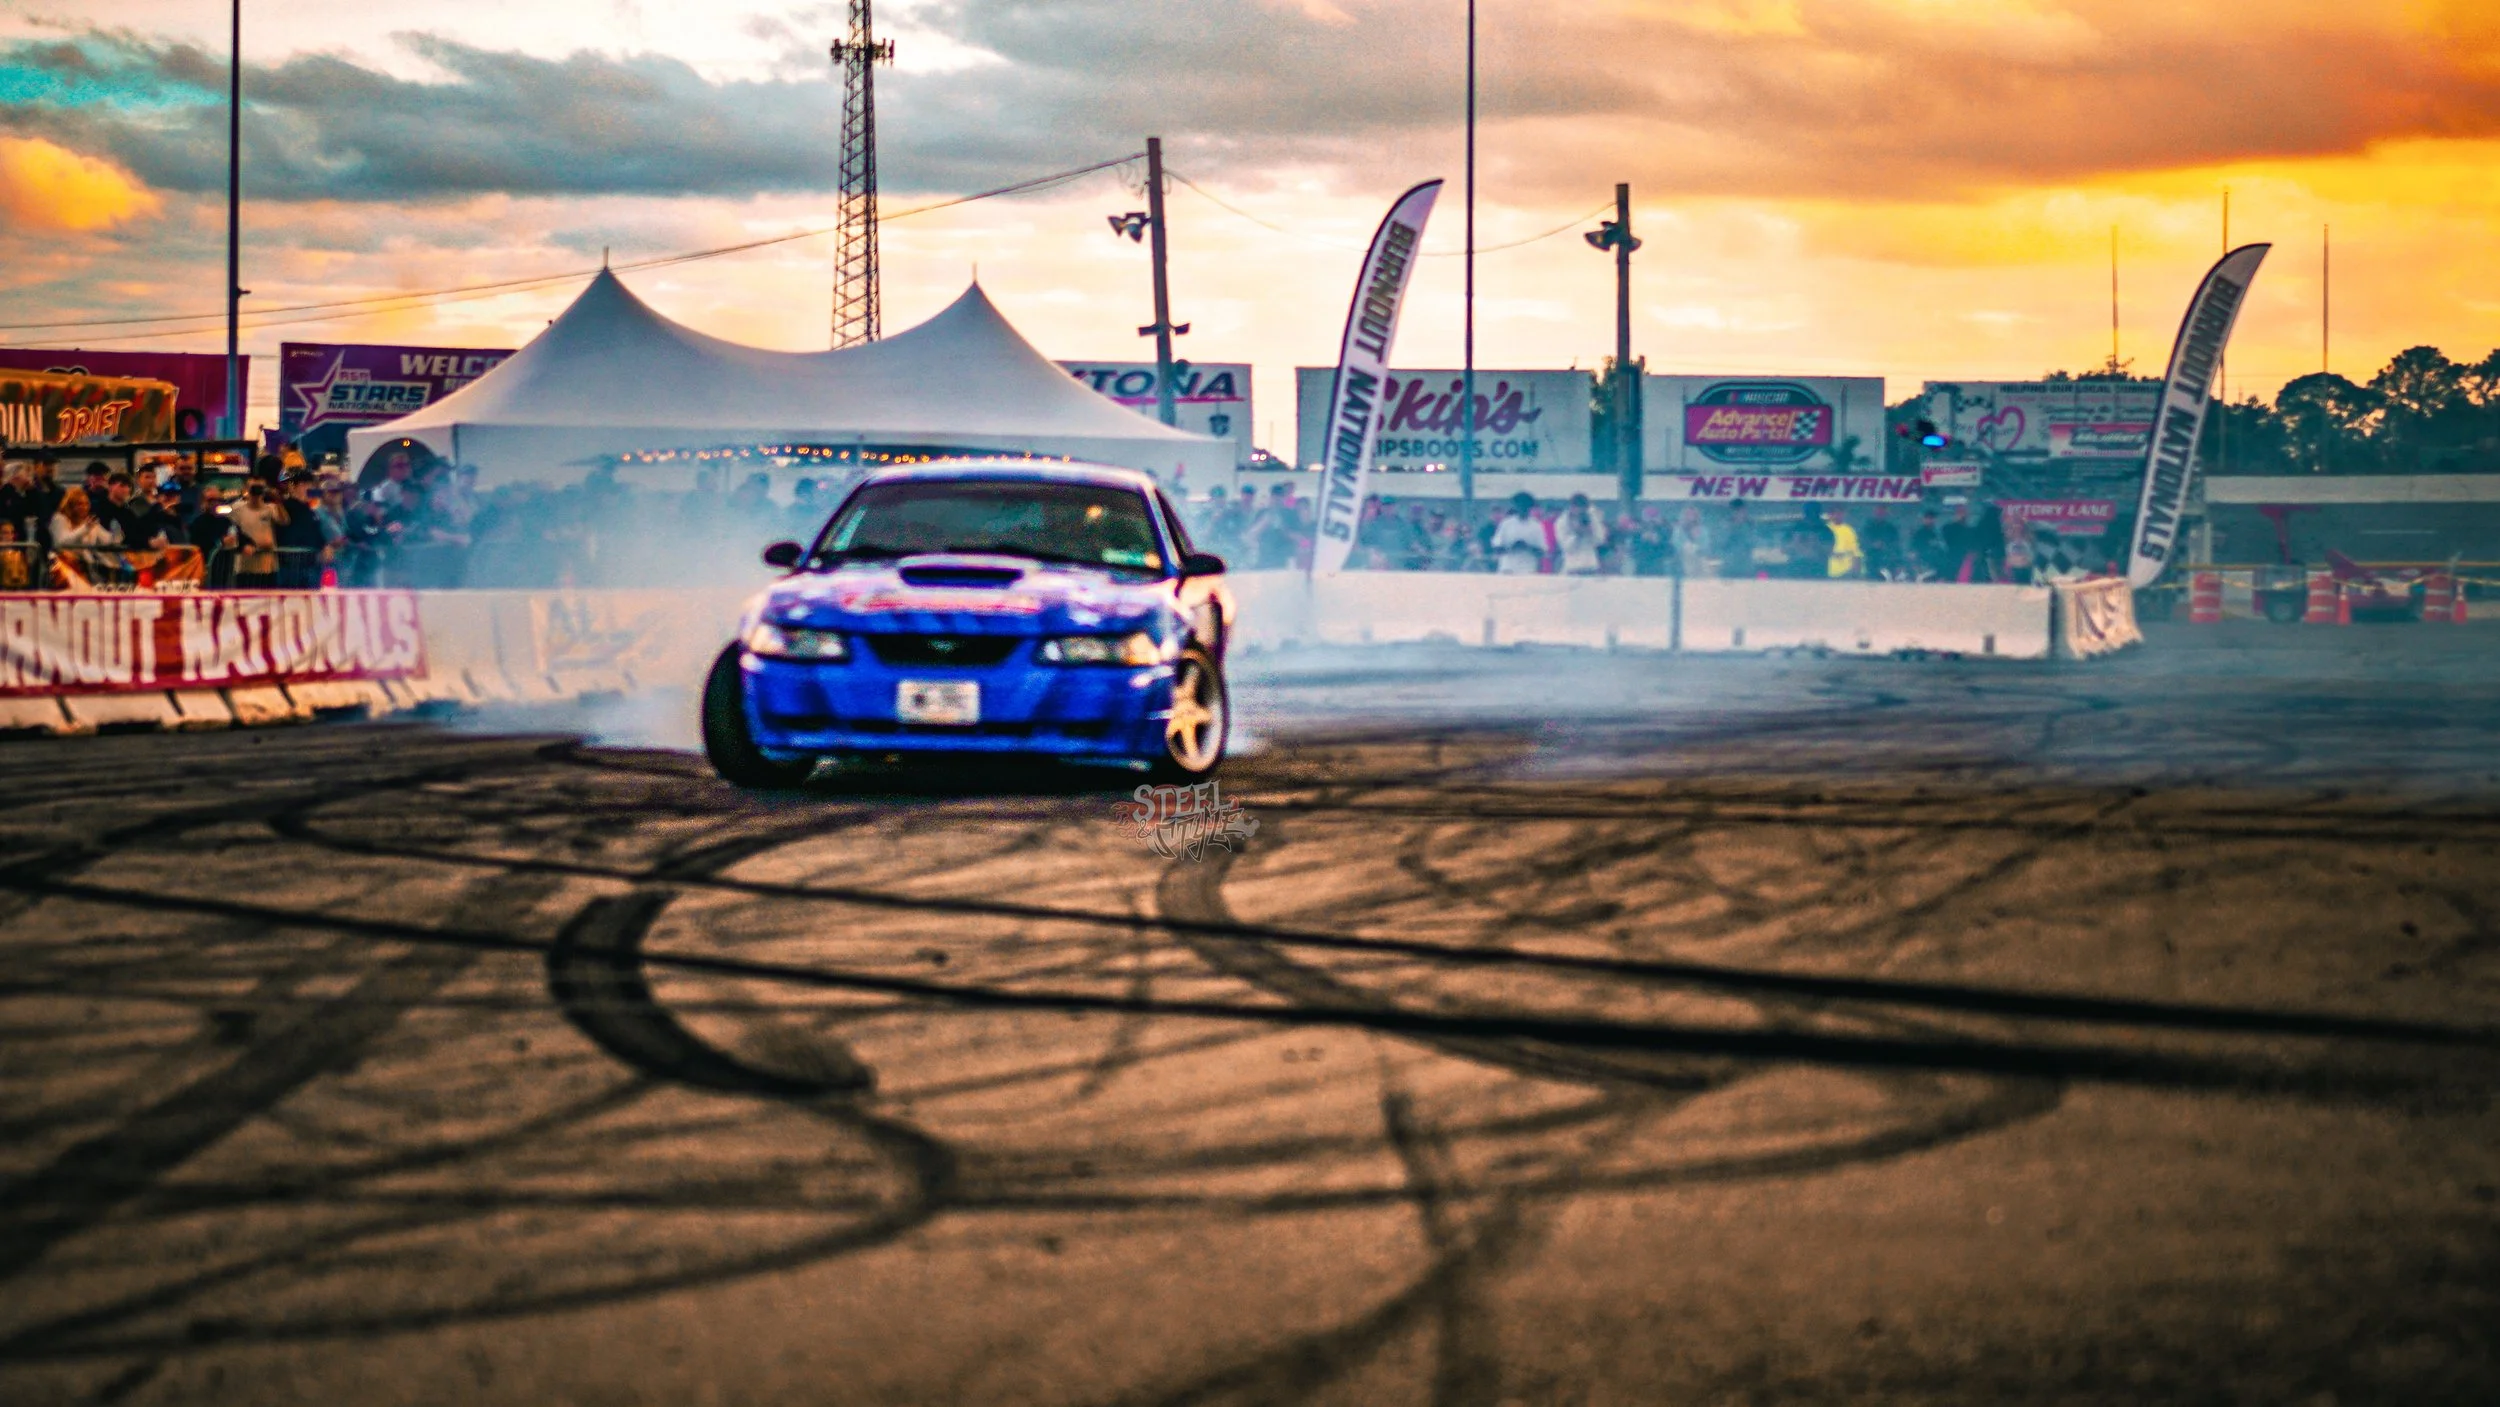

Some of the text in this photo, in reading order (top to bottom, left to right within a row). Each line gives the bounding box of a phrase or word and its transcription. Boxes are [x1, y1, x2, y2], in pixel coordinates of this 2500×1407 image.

[330, 383, 426, 401] STARS
[1322, 219, 1418, 542] BURNOUT NATIONALS
[57, 401, 132, 443] DRIFT
[1696, 422, 1784, 440] Auto Parts
[1708, 409, 1789, 426] Advance
[2138, 275, 2241, 563] BURNOUT NATIONALS
[1681, 476, 1923, 499] NEW SMYRNA
[0, 592, 419, 689] RNOUT NATIONALS
